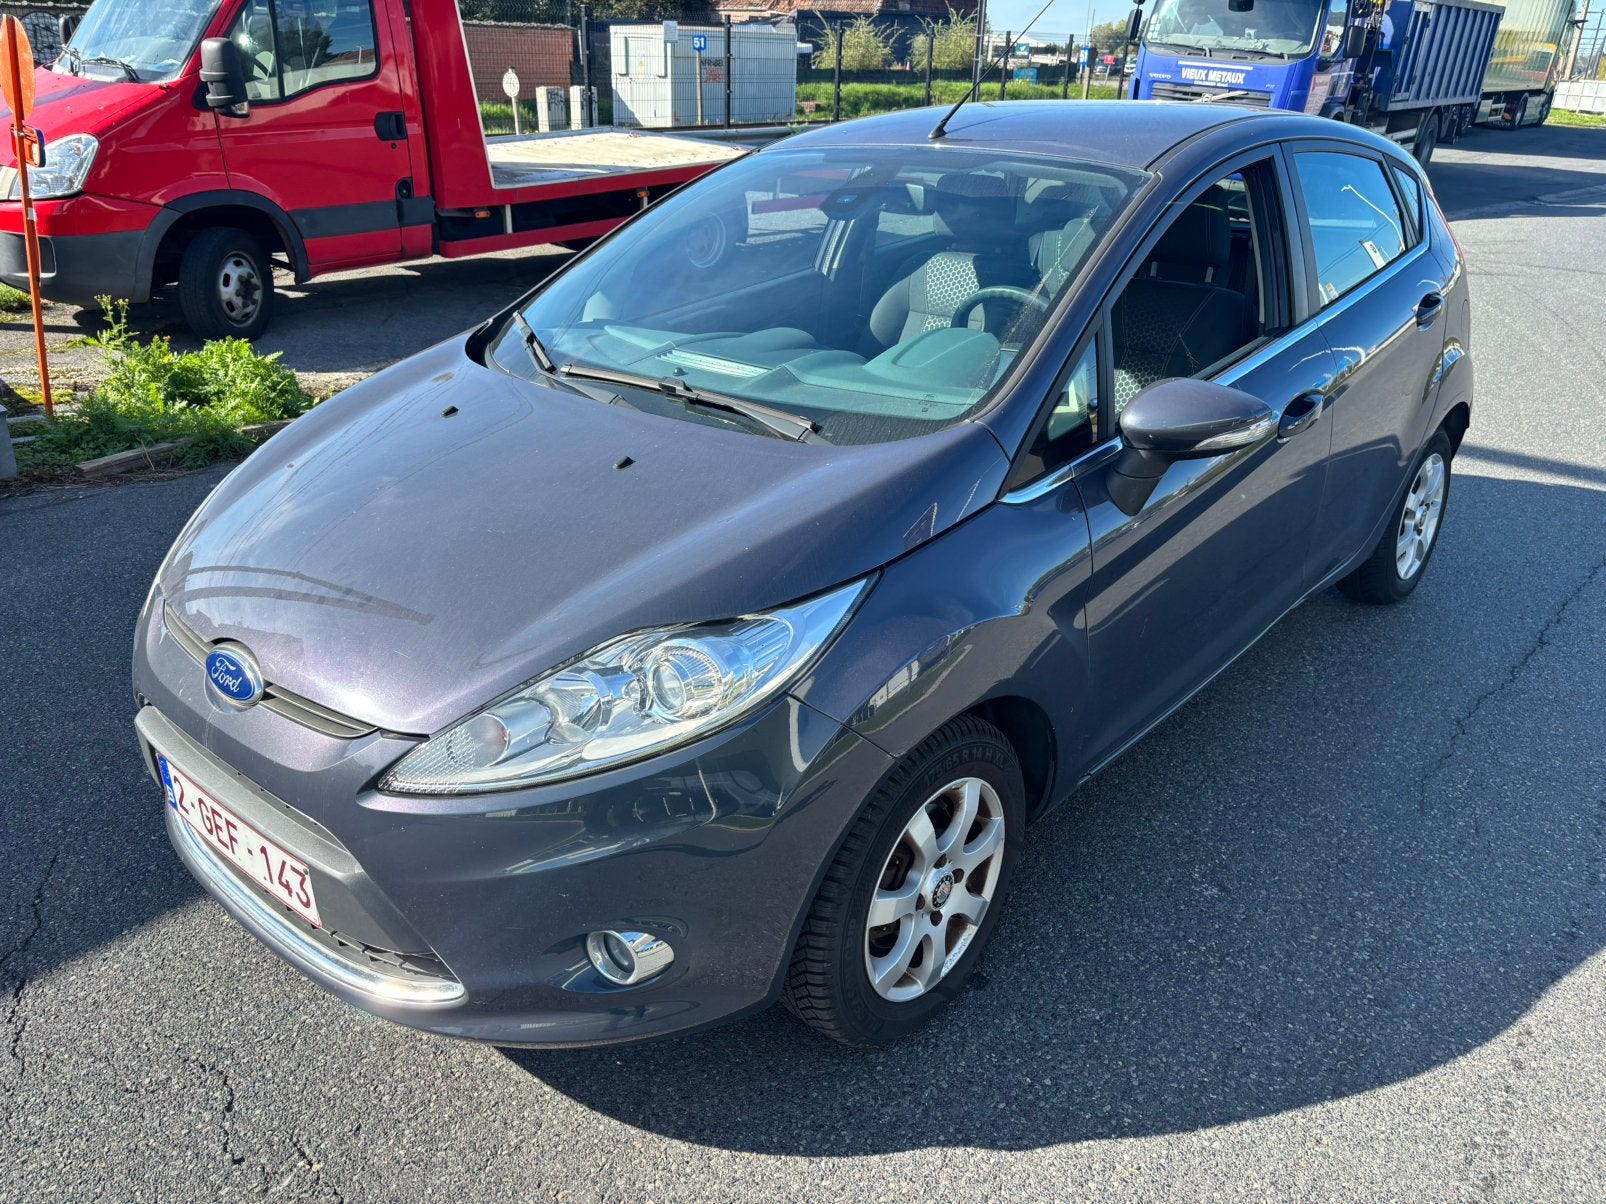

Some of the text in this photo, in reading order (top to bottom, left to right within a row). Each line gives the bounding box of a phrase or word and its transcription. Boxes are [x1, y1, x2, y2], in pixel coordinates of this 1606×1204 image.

[693, 37, 704, 48] 51
[1182, 67, 1207, 81] VIEUX
[1207, 70, 1245, 84] METAUX
[211, 657, 240, 694] Ford
